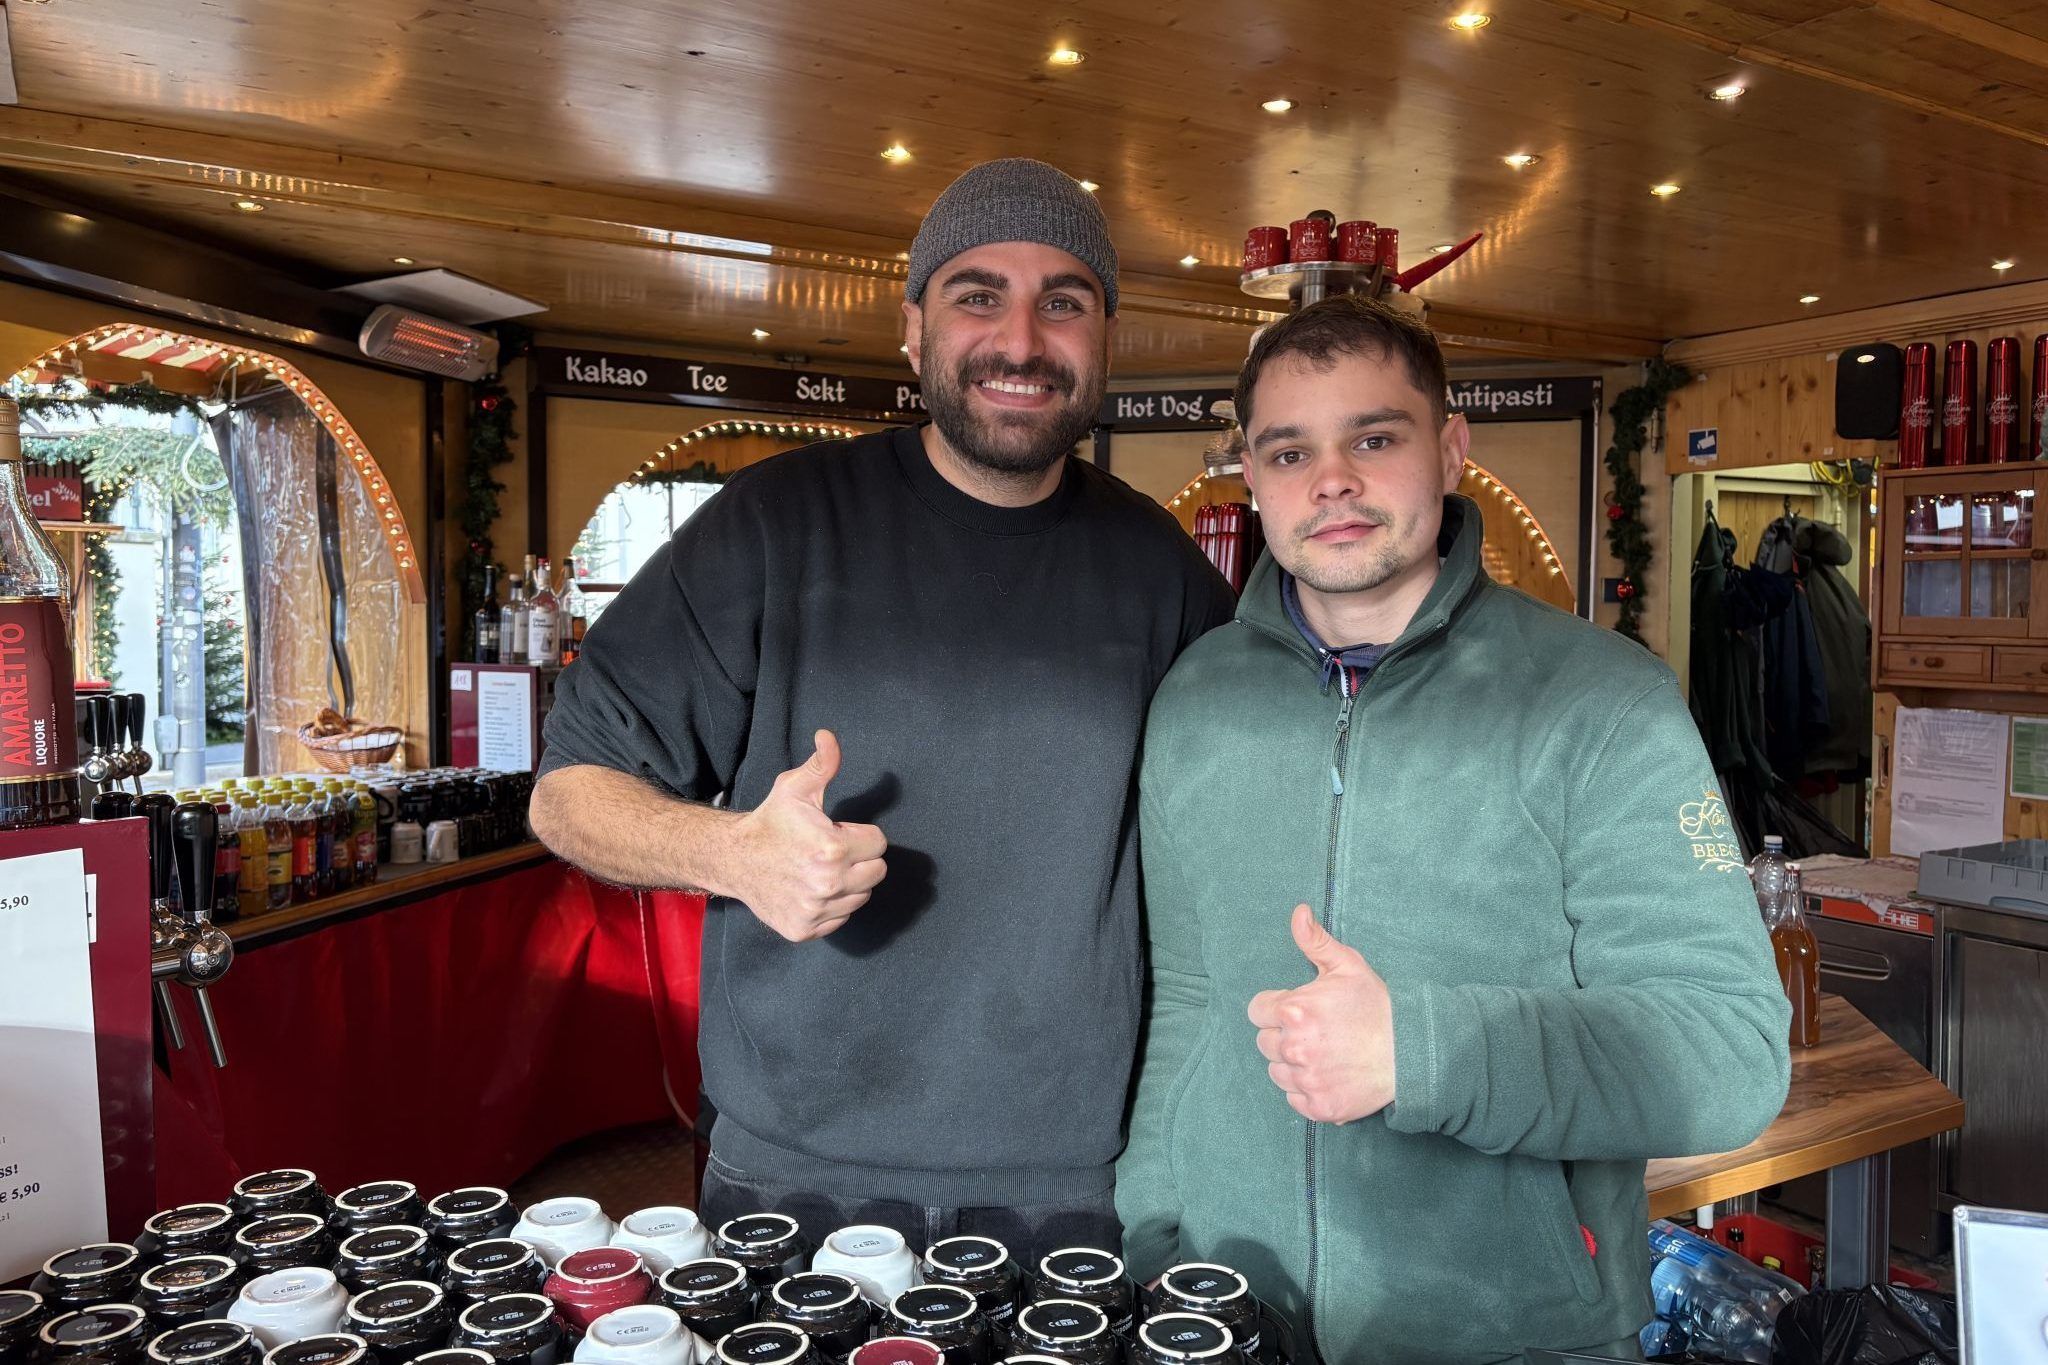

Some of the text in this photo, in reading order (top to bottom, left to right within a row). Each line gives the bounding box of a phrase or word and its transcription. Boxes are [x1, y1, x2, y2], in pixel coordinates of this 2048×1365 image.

[565, 356, 648, 387] Kakao
[687, 365, 728, 393] Tee
[796, 376, 846, 403] Sekt
[1446, 383, 1553, 413] Antipasti
[1117, 395, 1203, 421] Hot Dog
[0, 622, 32, 767] AMARETTO
[34, 718, 47, 766] LIQUORE
[12, 1182, 40, 1200] 5,90
